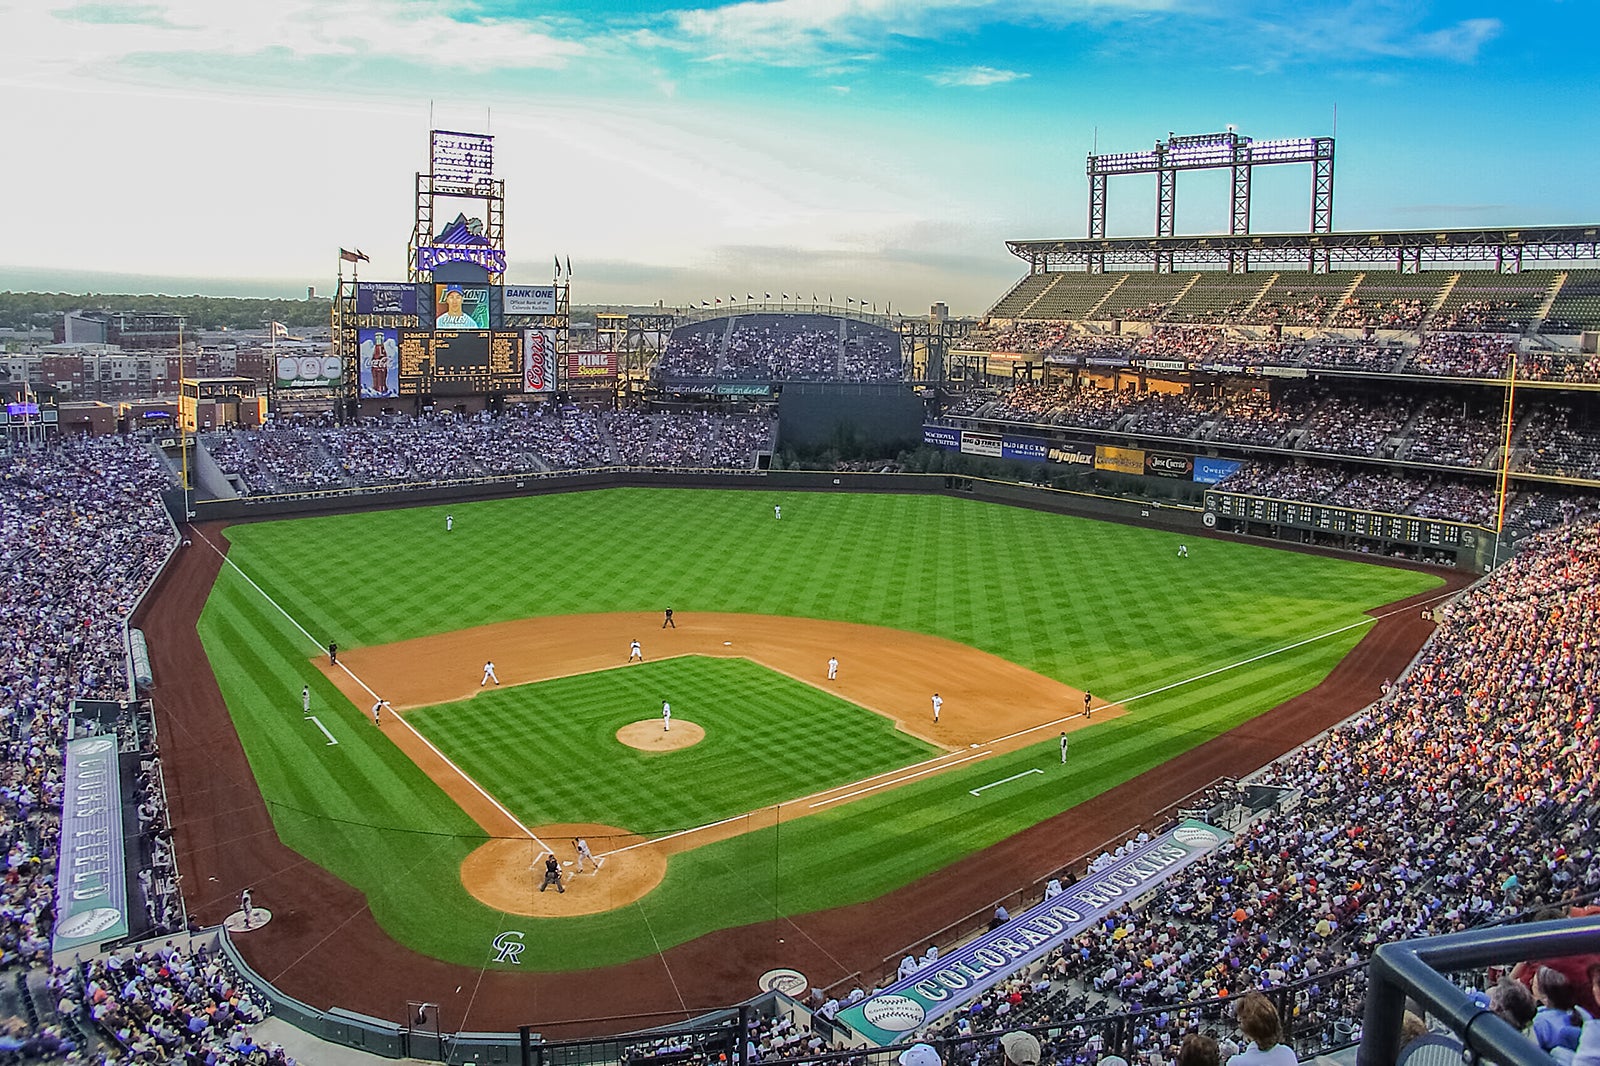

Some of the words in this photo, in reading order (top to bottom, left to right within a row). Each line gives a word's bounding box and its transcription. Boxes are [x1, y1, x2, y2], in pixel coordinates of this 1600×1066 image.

[417, 246, 507, 273] ROCKIES
[506, 289, 531, 298] BANK
[527, 331, 545, 389] Coors
[578, 354, 608, 365] KING
[1048, 448, 1092, 465] Myoplex
[1152, 456, 1165, 467] Jose
[1202, 465, 1225, 475] Qwest
[914, 904, 1081, 1002] COLORADO
[1073, 843, 1187, 910] ROCKIES
